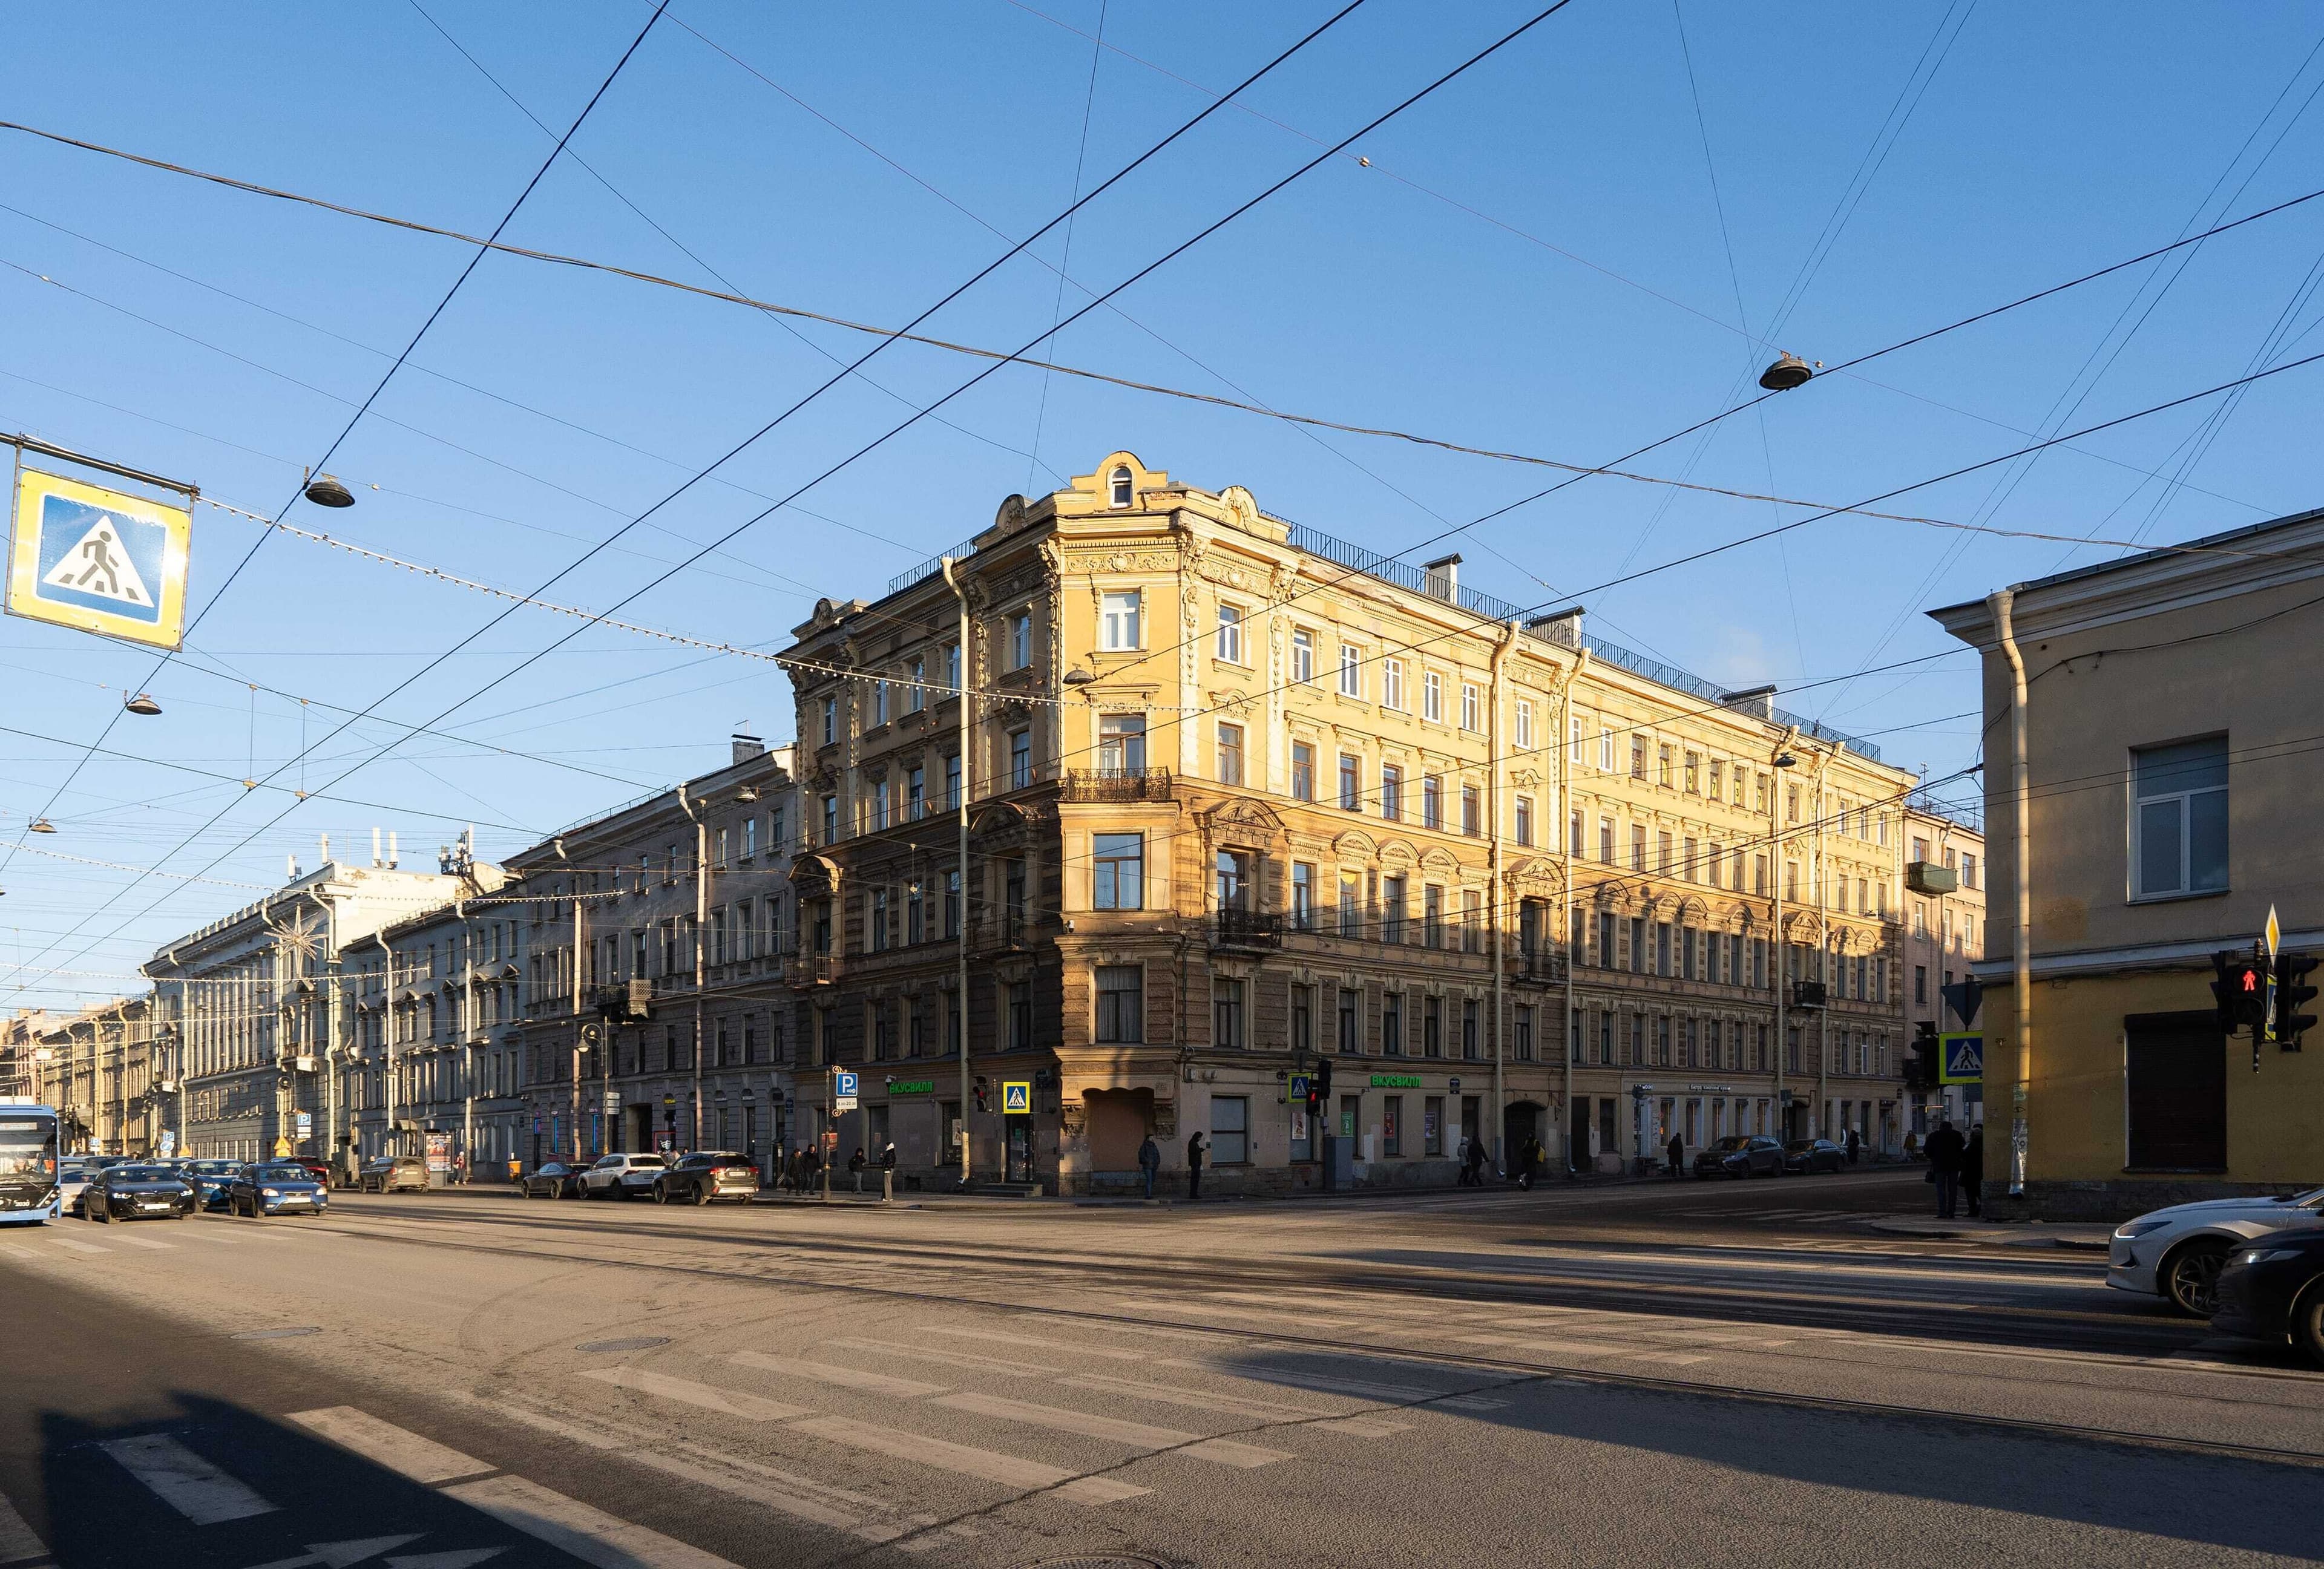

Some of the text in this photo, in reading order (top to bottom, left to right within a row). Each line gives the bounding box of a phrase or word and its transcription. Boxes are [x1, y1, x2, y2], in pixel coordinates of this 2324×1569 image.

[842, 1075, 854, 1093] P
[889, 1081, 934, 1095] ВКУСВИЛЛ
[1371, 1075, 1422, 1087] ВКУСВИЛЛ
